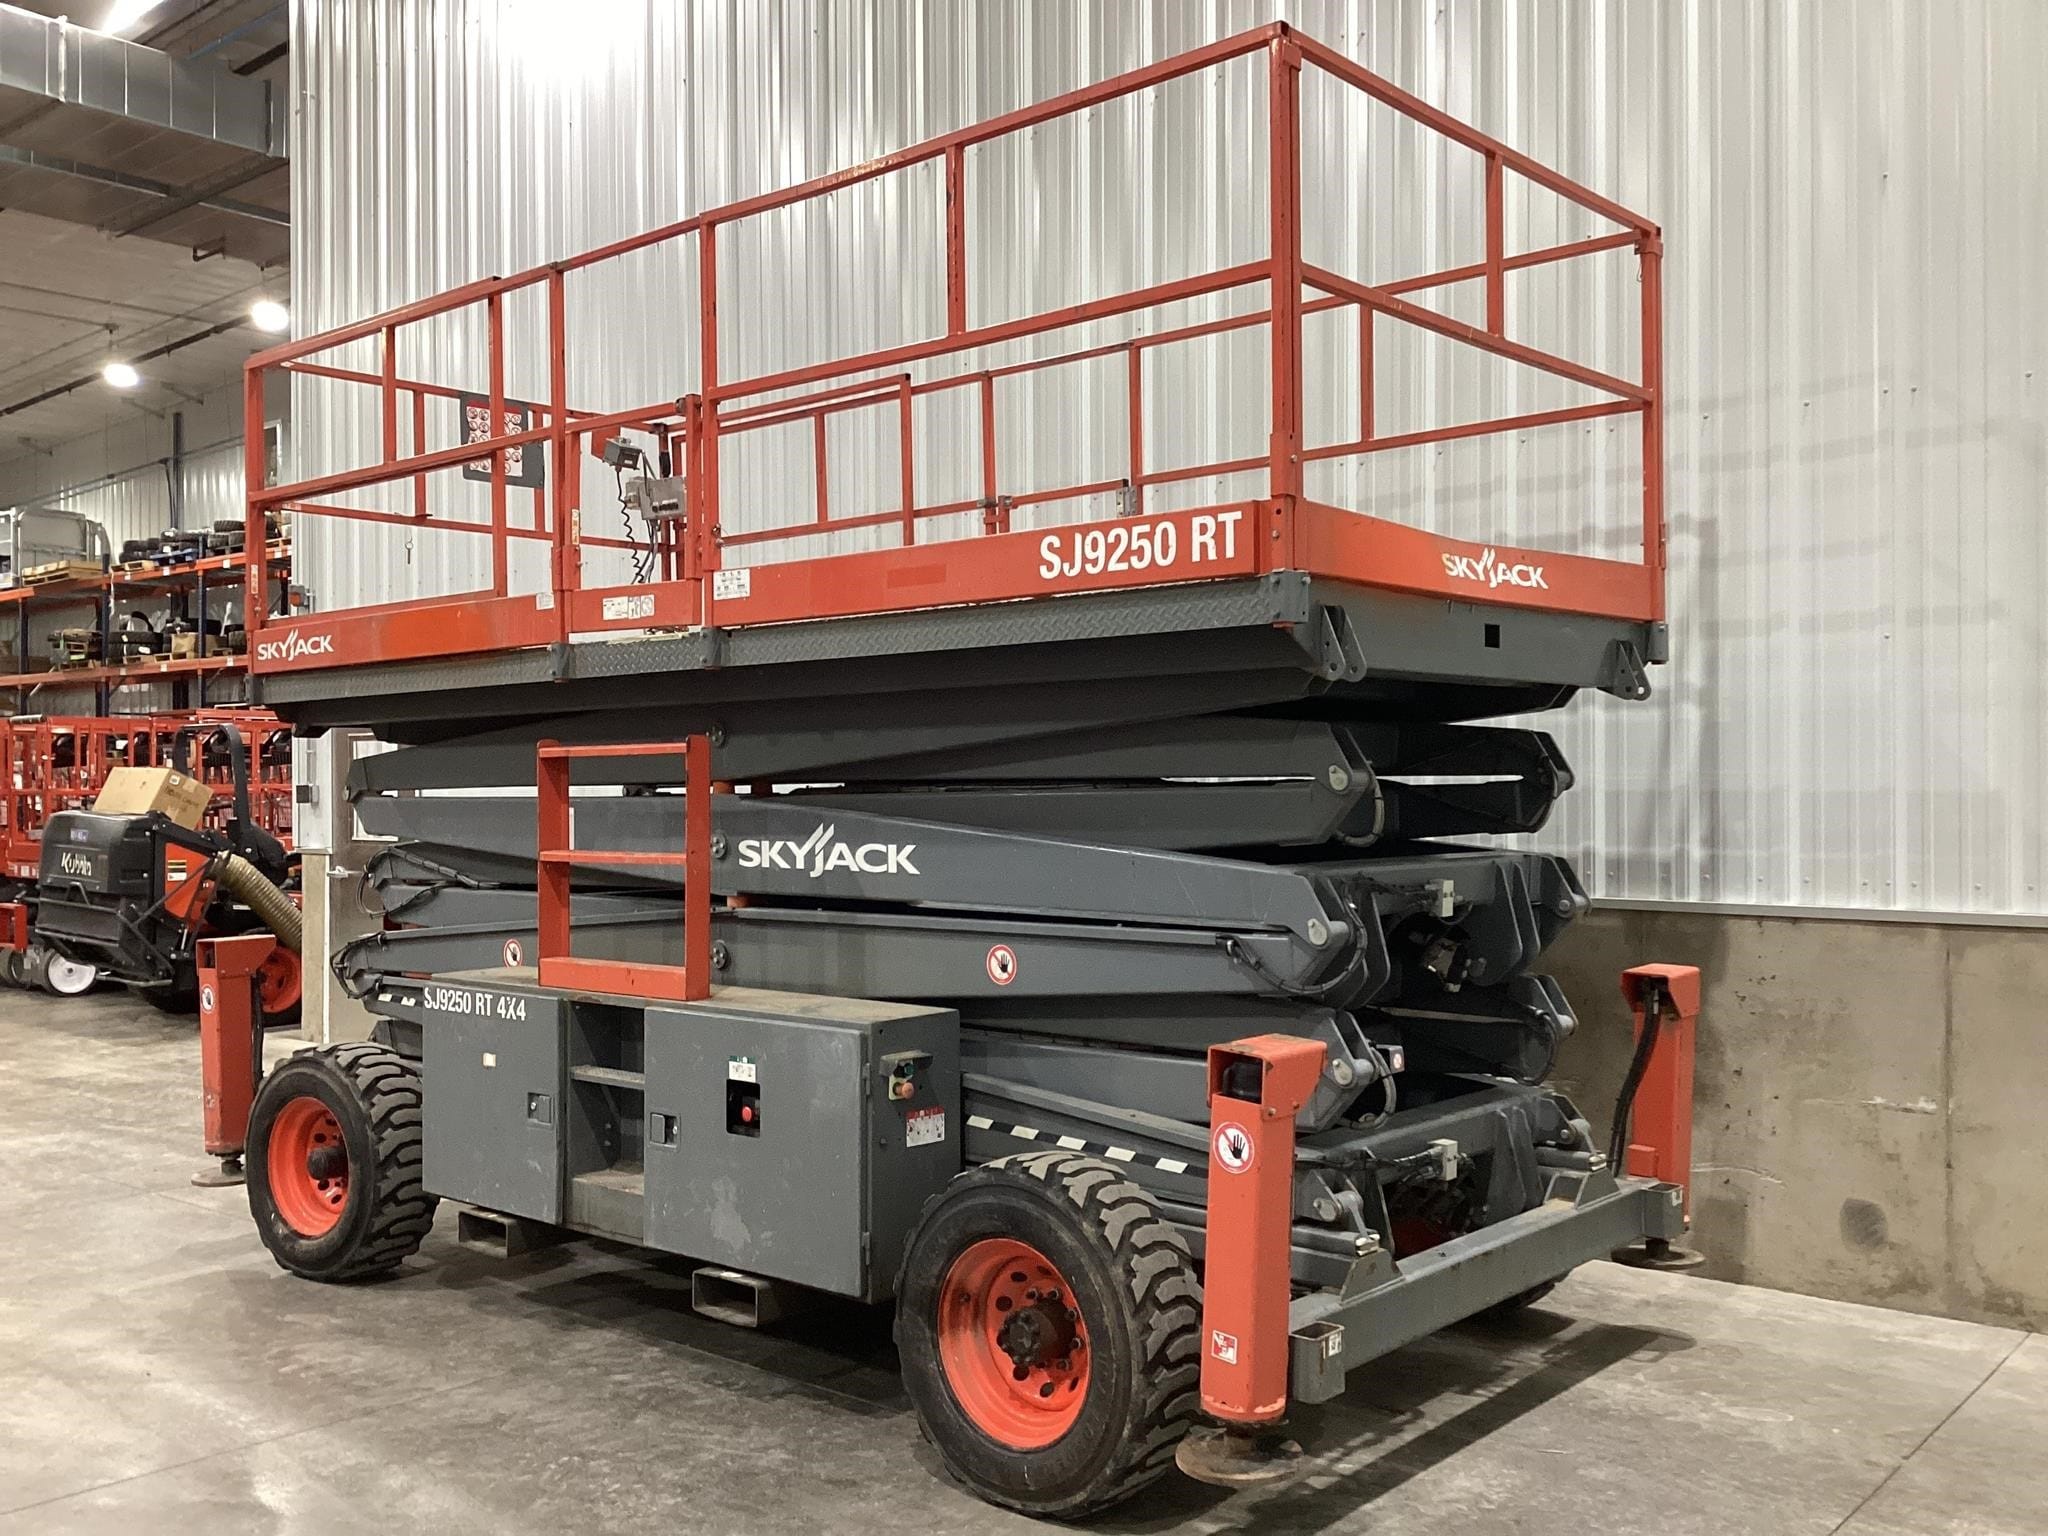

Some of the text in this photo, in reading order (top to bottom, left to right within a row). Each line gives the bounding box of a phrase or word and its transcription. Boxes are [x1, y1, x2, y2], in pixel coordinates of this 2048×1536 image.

[1039, 510, 1243, 580] SJ9250 RT
[1441, 546, 1549, 590] SKYJACK
[257, 628, 335, 662] SKYJACK
[737, 822, 921, 878] SKYJACK
[424, 987, 527, 1021] SJ9250 RT 4X4
